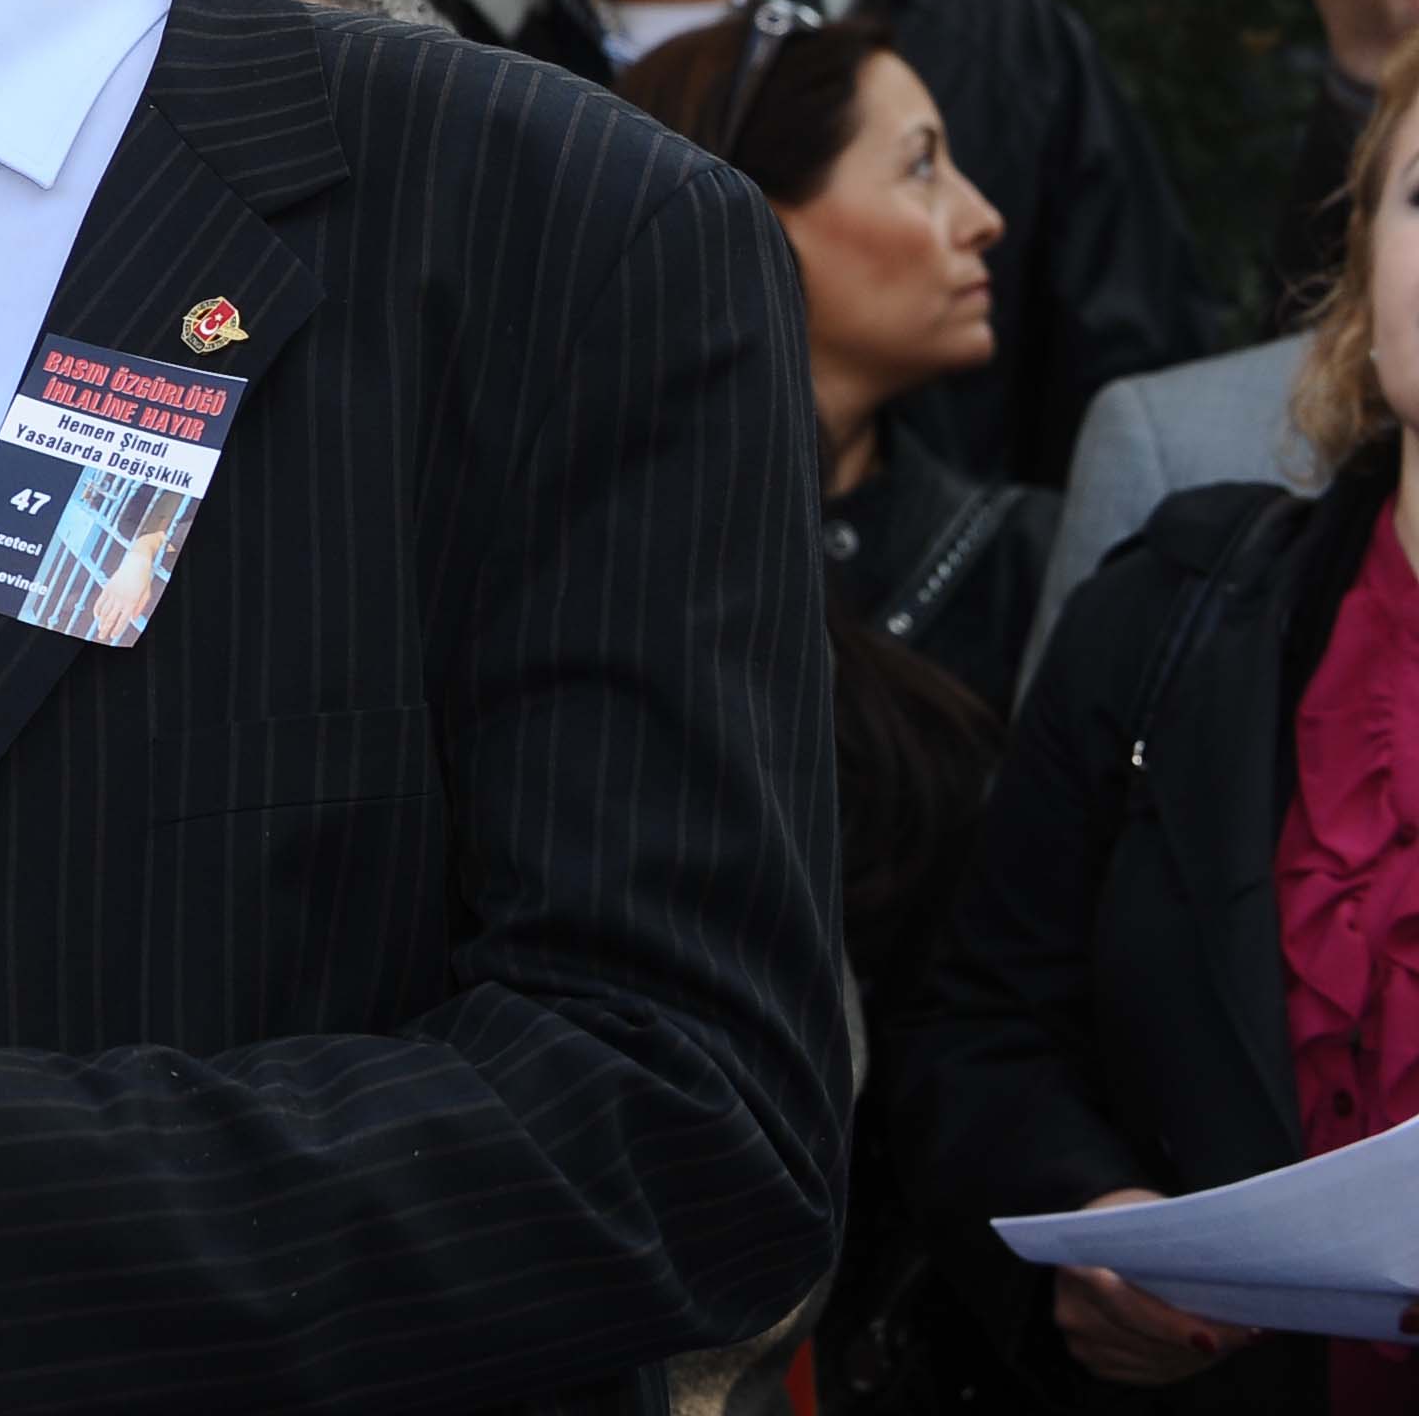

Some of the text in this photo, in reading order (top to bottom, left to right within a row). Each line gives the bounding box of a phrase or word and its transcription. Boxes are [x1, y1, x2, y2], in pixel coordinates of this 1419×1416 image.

[42, 376, 205, 442] İHLALİNE HAYIR
[43, 350, 228, 417] BASIN ÖZGÜRLÜĞÜ
[15, 422, 194, 489] Yasalarda Değişiklik
[58, 413, 169, 459] Hemen Şimdi
[10, 487, 51, 516] 47
